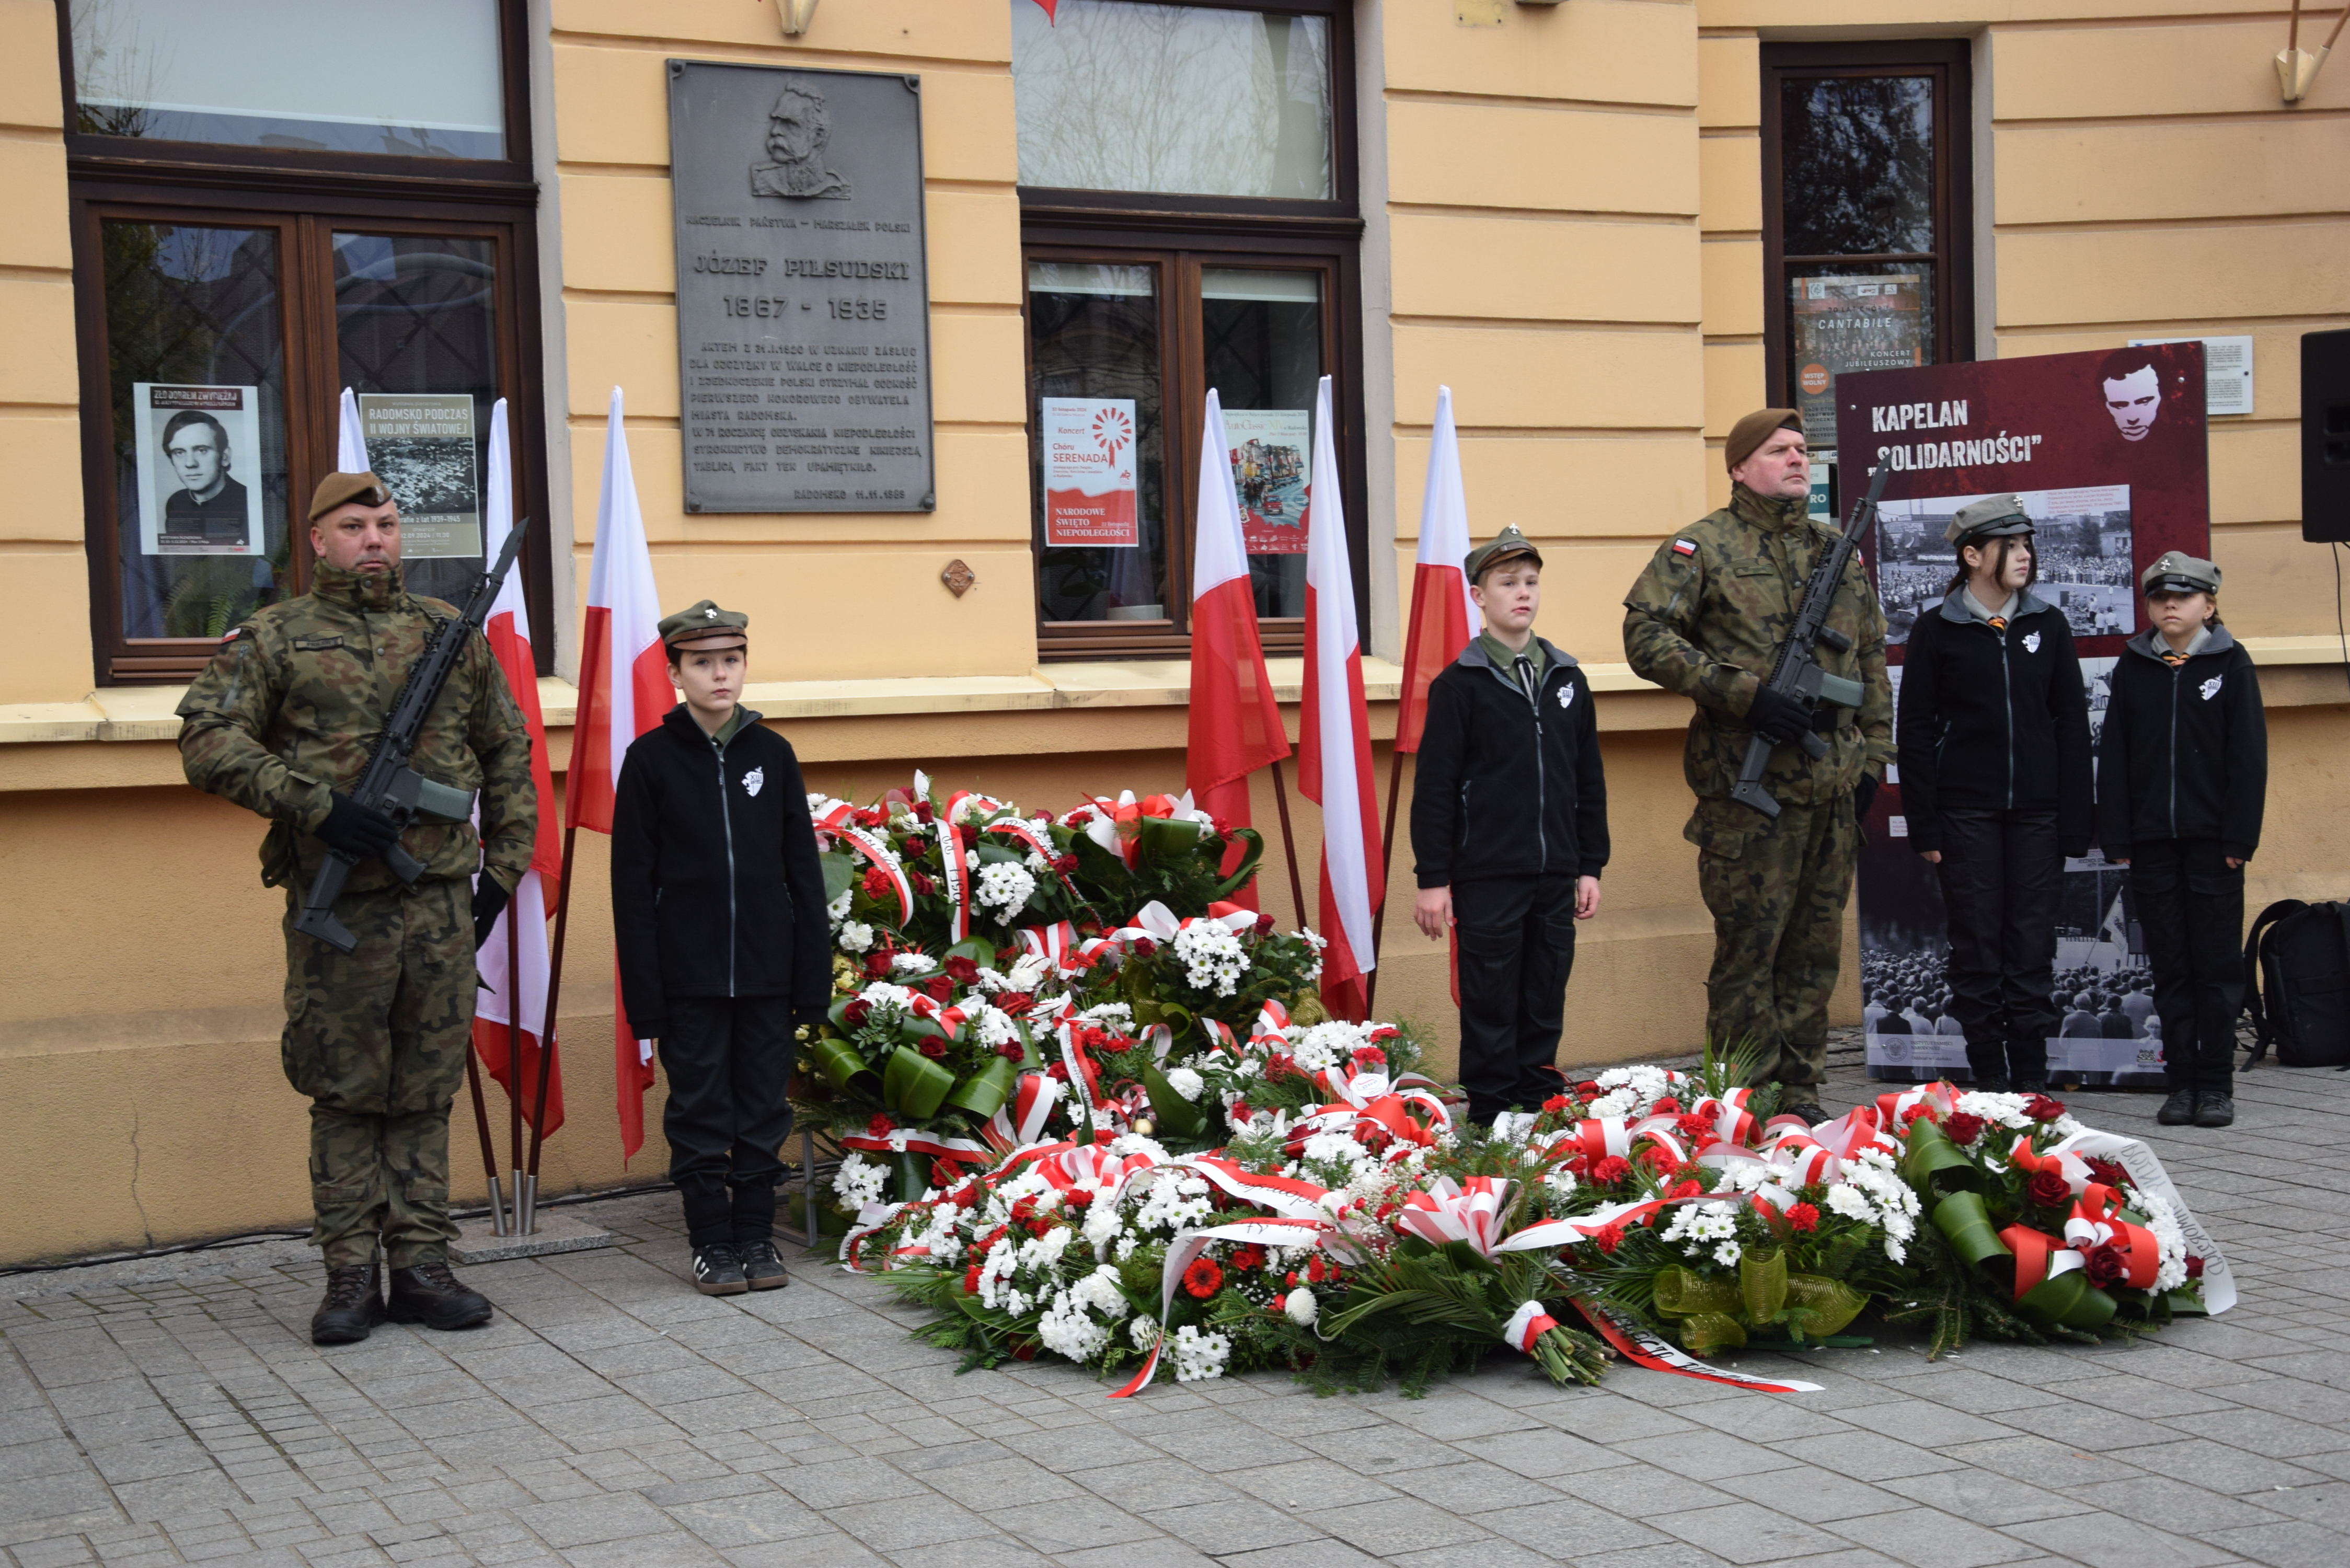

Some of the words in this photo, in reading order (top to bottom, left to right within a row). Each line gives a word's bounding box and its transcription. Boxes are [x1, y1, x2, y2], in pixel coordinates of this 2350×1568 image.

[686, 215, 741, 226] NACZELNIK
[750, 216, 797, 228] PAŃSTWA
[813, 219, 871, 232] MARSZAŁEK
[874, 221, 911, 233] POLSKI
[694, 248, 768, 276] JÓZEF
[784, 258, 910, 280] PIŁSUDSKI
[723, 294, 788, 318] 1867
[827, 296, 888, 320] 1935
[1818, 317, 1892, 329] CANTABILE
[701, 342, 738, 352] AKTEM
[743, 343, 751, 353] Z
[809, 345, 819, 355] W
[824, 345, 869, 356] UZNANIU
[874, 346, 917, 356] ZASŁUG
[689, 358, 709, 368] DLA
[713, 360, 767, 371] OJCZYZNY
[770, 361, 781, 371] W
[786, 361, 822, 371] WALCE
[826, 362, 833, 372] O
[1845, 359, 1911, 367] JUBILEUSZOWY
[698, 376, 775, 387] ZJEDNOCZENIE
[780, 377, 815, 387] POLSKI
[819, 378, 869, 388] OTRZYMAŁ
[690, 393, 759, 403] PIERWSZEGO
[767, 394, 842, 404] HONOROWEGO
[848, 395, 910, 405] OBYWATELA
[369, 408, 422, 420] RADOMSKO
[424, 408, 468, 420] PODCZAS
[691, 410, 730, 420] MIASTA
[738, 410, 798, 421] RADOMSKA.
[1871, 399, 1968, 433] KAPELAN
[370, 423, 376, 434] II
[378, 423, 410, 434] WOJNY
[412, 421, 467, 434] ŚWIATOWEJ
[692, 427, 702, 437] W
[718, 428, 766, 440] ROCZNICĘ
[770, 428, 827, 438] ODZYSKANIA
[833, 425, 916, 438] NIEPODLEGŁOŚCI
[694, 445, 767, 454] STRONNICTWO
[776, 445, 860, 455] DEMOKRATYCZNE
[870, 445, 922, 457] NINIEJSZĄ
[1053, 453, 1109, 463] SERENADA
[694, 462, 736, 474] TABLICĄ
[744, 462, 769, 471] FAKT
[776, 462, 797, 472] TEN
[794, 489, 847, 500] RADOMSKO
[1056, 516, 1090, 528] ŚWIĘTO
[1056, 527, 1130, 536] NIEPODLEGŁOŚCI
